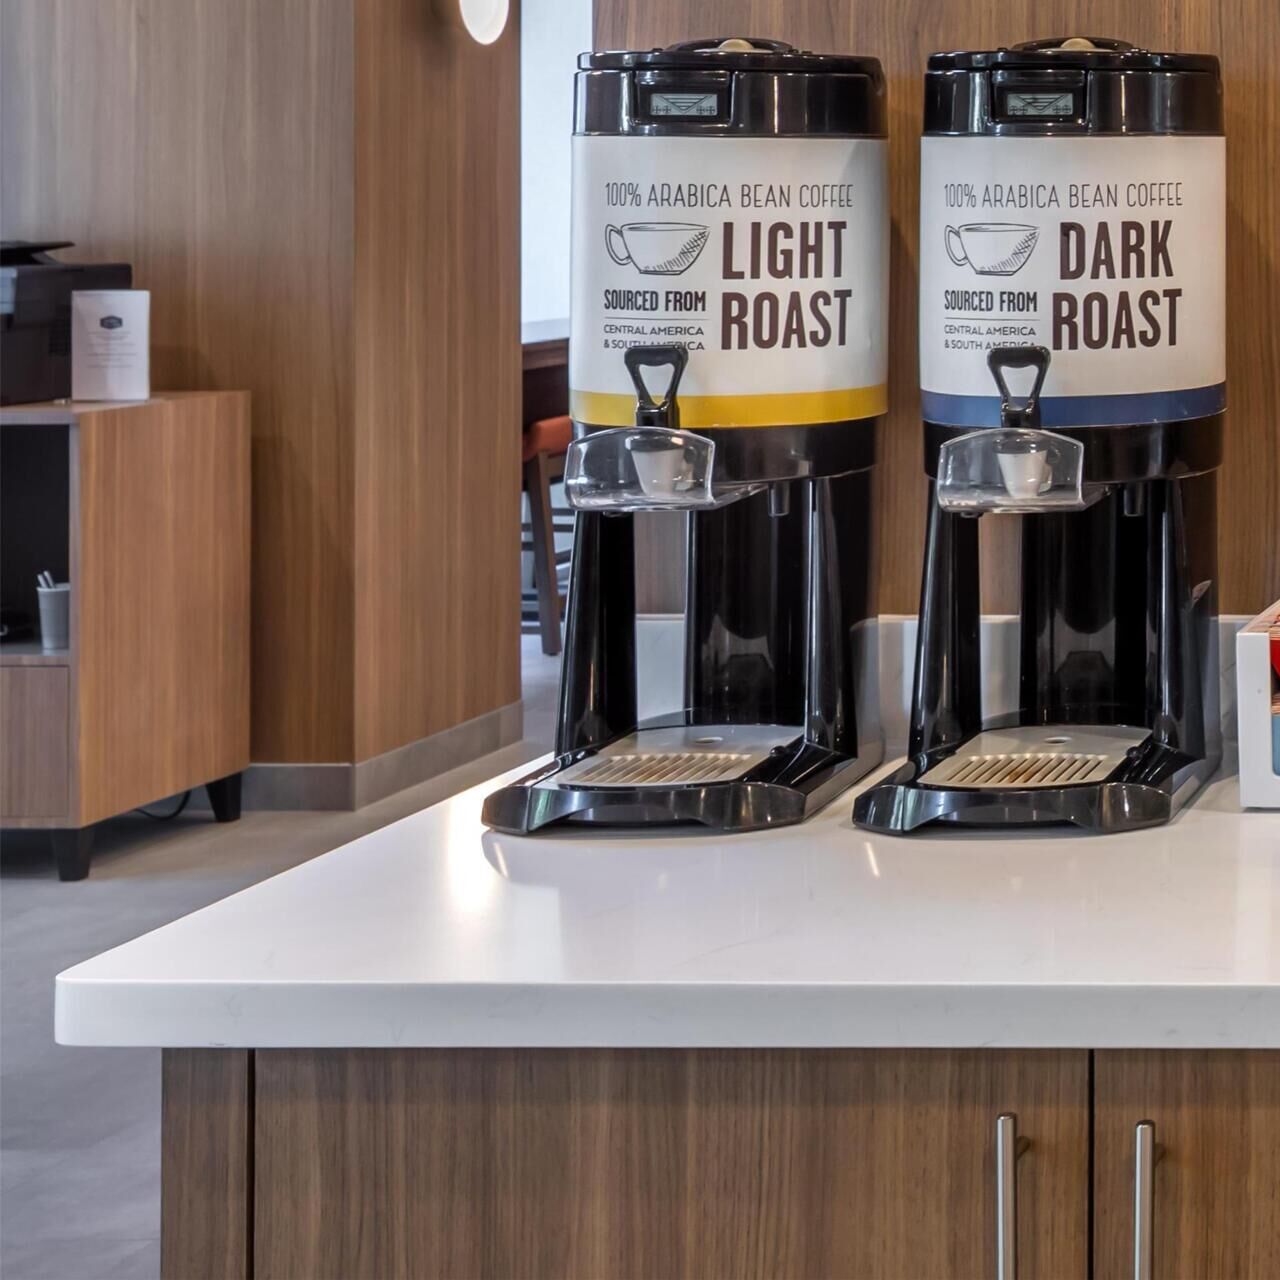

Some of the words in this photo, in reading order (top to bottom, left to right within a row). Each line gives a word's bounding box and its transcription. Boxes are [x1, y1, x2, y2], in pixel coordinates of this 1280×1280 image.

[605, 183, 641, 207] 100%
[647, 183, 732, 207] ARABICA
[741, 184, 791, 208] BEAN
[799, 184, 853, 208] COFFEE
[944, 183, 977, 208] 100%
[982, 184, 1060, 208] ARABICA
[1069, 184, 1118, 208] BEAN
[1126, 182, 1183, 208] COFFEE
[722, 221, 847, 280] LIGHT
[1060, 220, 1174, 280] DARK
[604, 289, 659, 311] SOURCED
[664, 291, 706, 312] FROM
[944, 290, 994, 312] SOURCED
[999, 291, 1038, 312] FROM
[603, 324, 648, 335] CENTRAL
[649, 326, 705, 336] AMERICA
[721, 289, 852, 350] ROAST
[944, 324, 984, 335] CENTRAL
[985, 326, 1037, 336] AMERICA
[1052, 288, 1182, 351] ROAST
[951, 339, 983, 350] SOUTH
